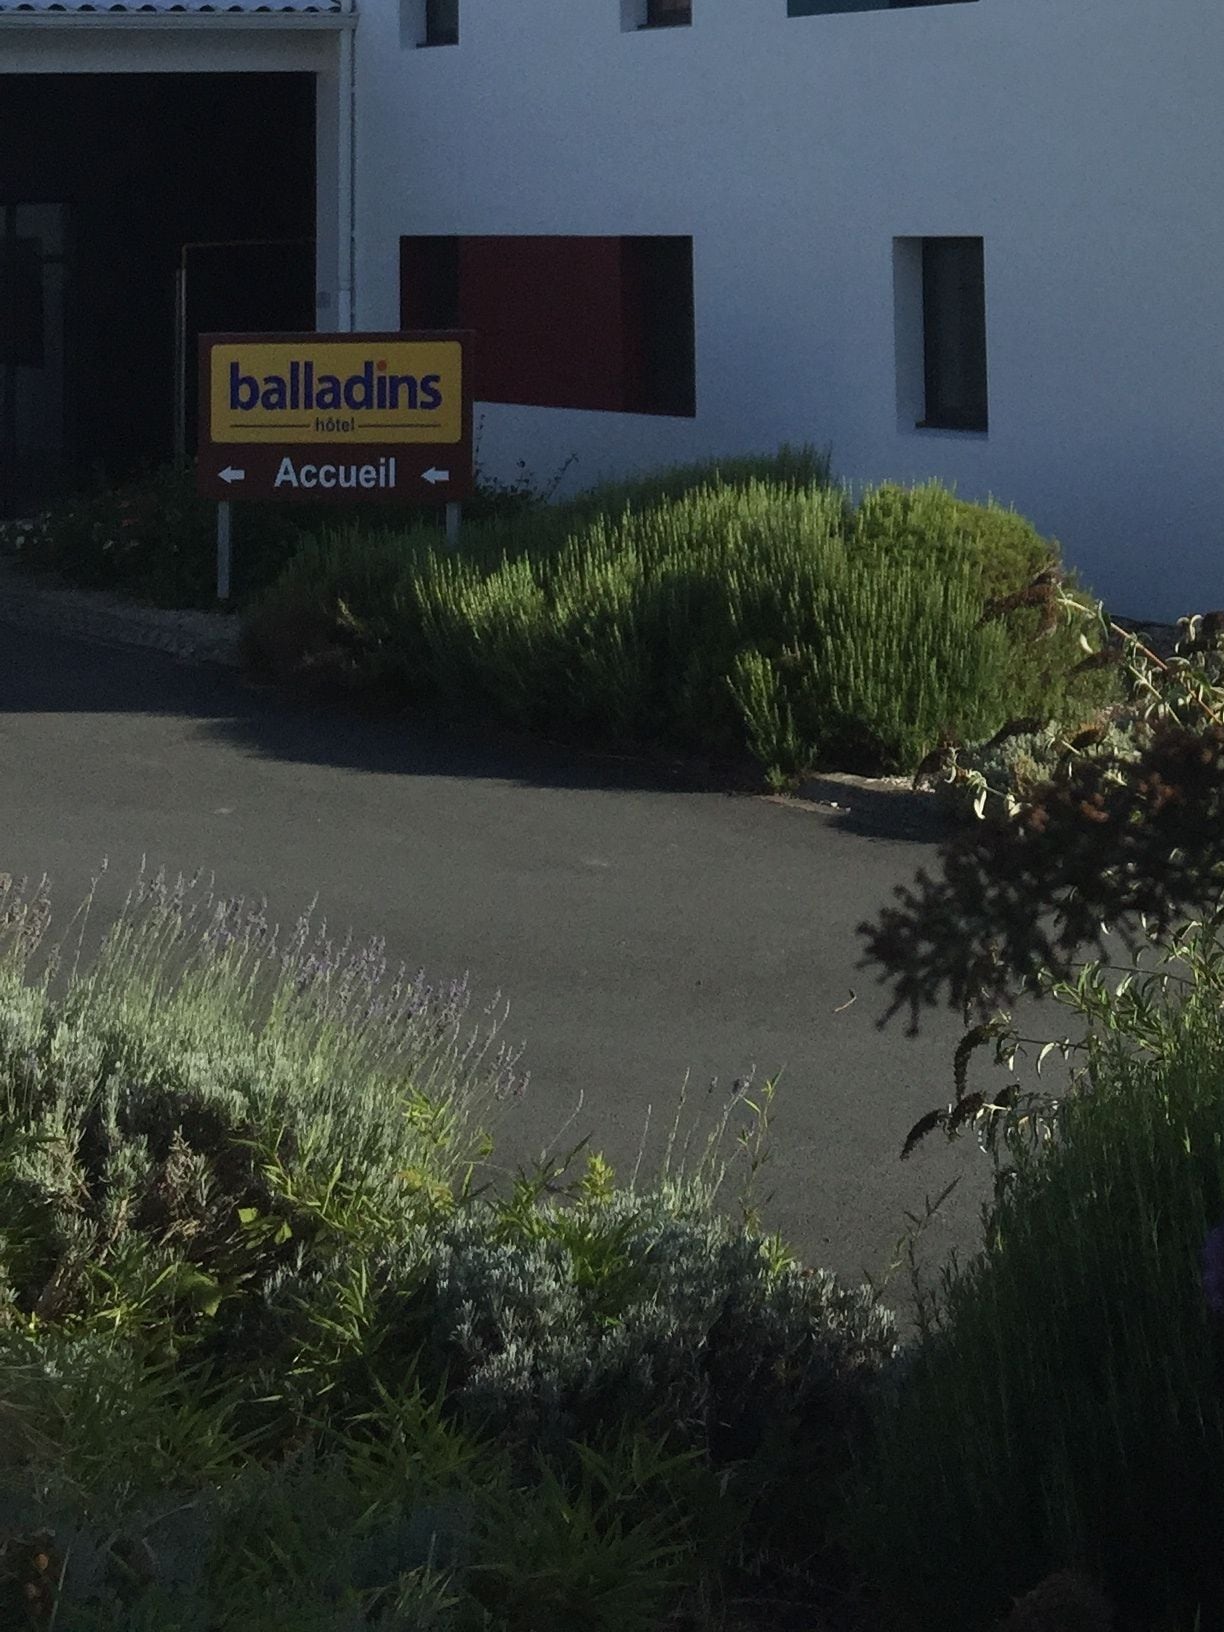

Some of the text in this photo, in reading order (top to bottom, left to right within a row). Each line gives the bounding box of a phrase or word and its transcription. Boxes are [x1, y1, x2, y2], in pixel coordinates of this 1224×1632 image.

[229, 360, 442, 410] balladins
[315, 417, 355, 433] hôtel
[274, 457, 396, 488] Accueil
